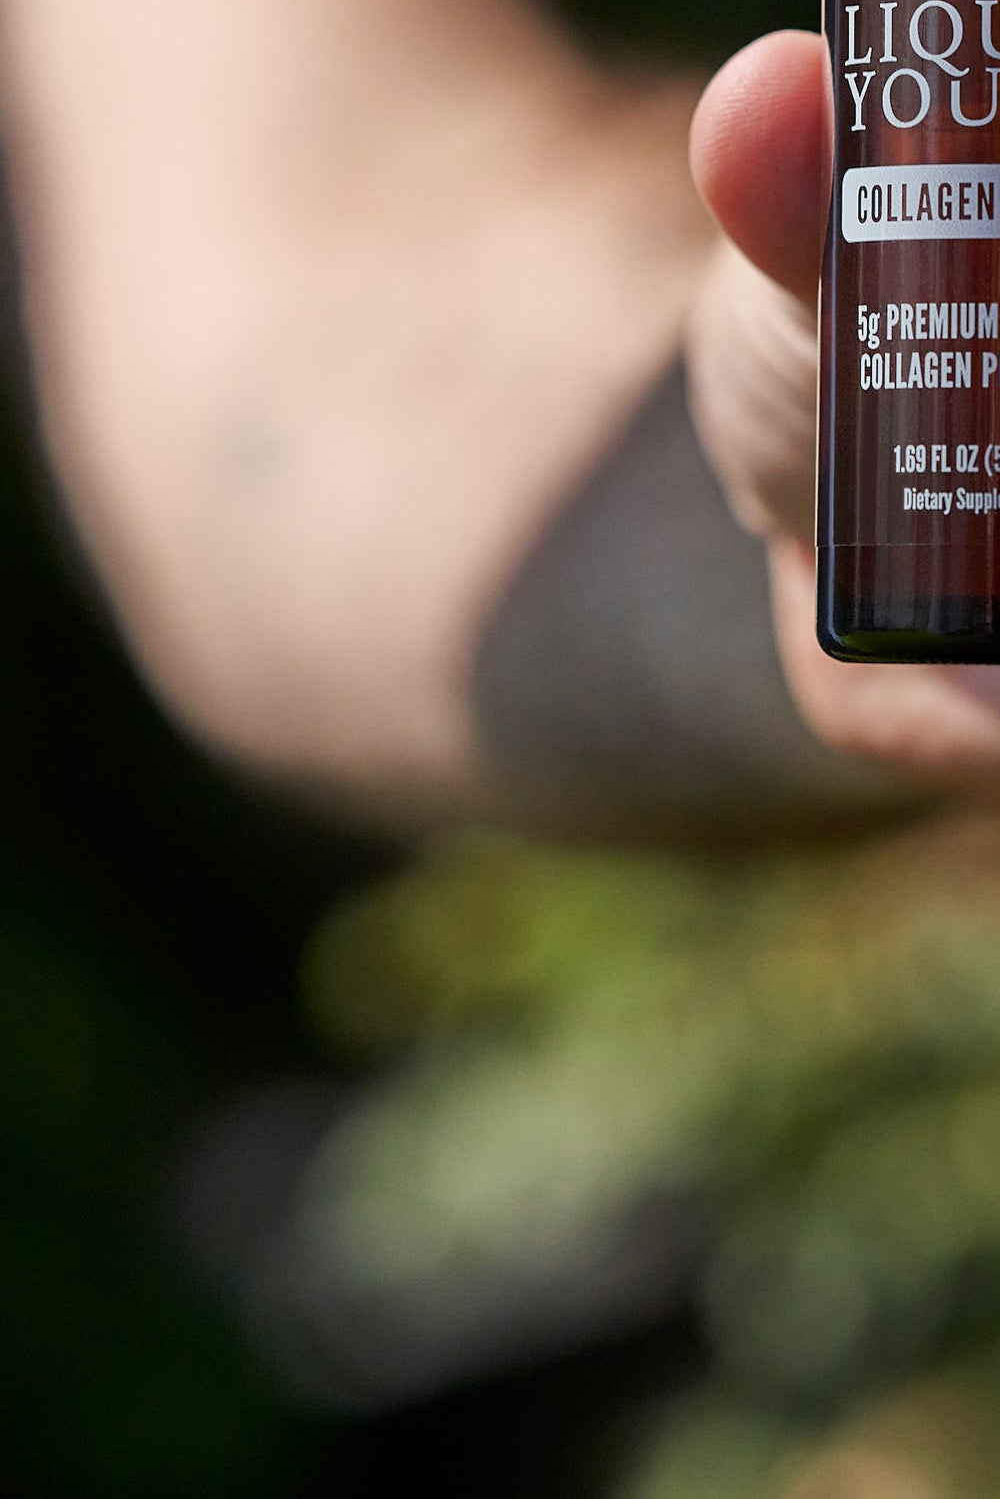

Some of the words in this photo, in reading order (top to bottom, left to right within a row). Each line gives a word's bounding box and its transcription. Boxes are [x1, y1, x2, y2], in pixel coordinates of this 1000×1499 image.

[857, 182, 995, 223] COLLAGEN
[857, 304, 881, 350] 5g
[886, 302, 999, 341] PREMIUM
[860, 352, 972, 390] COLLAGEN
[894, 444, 926, 474] 1.69
[931, 444, 952, 473] FL
[956, 444, 979, 473] OZ
[903, 488, 952, 515] Dietary
